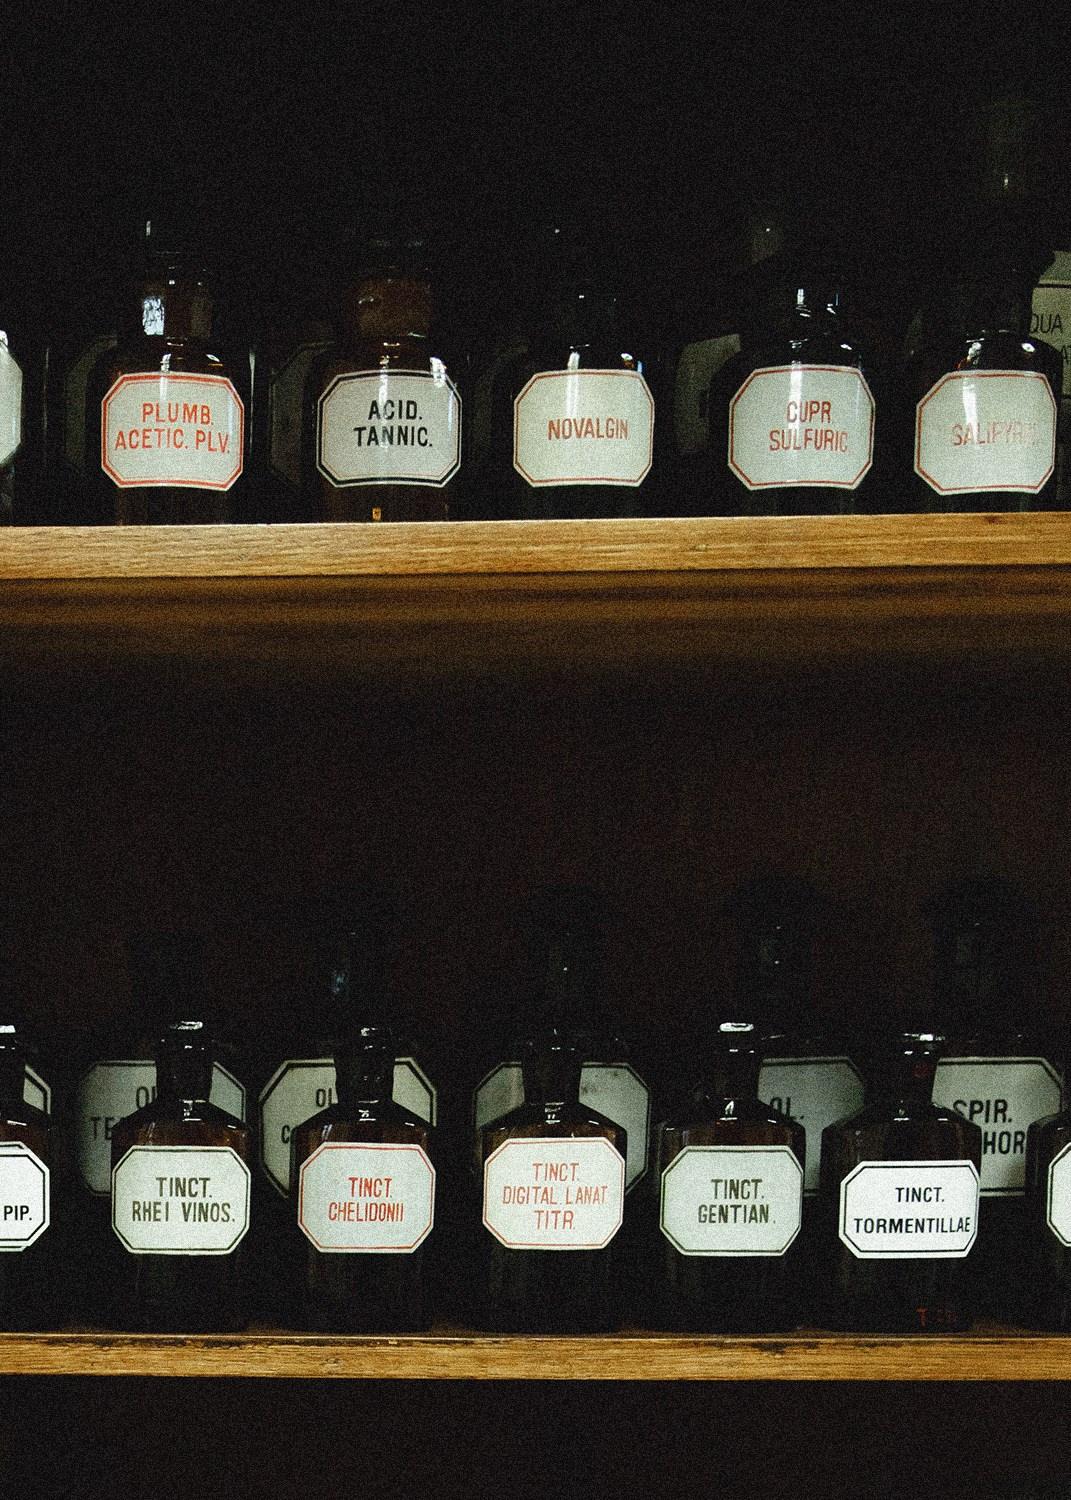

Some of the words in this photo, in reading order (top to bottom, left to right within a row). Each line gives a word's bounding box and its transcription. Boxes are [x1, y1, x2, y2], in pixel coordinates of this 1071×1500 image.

[142, 402, 215, 426] PLUMB.
[367, 399, 423, 420] ACID.
[786, 400, 832, 423] CUPR
[353, 425, 433, 447] TANNIC.
[548, 416, 629, 440] NOVALGIN
[114, 428, 189, 451] ACETIC.
[195, 429, 230, 454] PLV.
[769, 428, 849, 453] SULFURIC
[952, 1098, 1013, 1124] SPIR.
[532, 1162, 581, 1182] TINCT.
[156, 1176, 213, 1199] TINCT.
[348, 1177, 393, 1199] TINCT.
[711, 1178, 765, 1200] TINCT.
[895, 1186, 946, 1203] TINCT.
[3, 1205, 33, 1221] PIP.
[131, 1201, 169, 1222] RHEI
[181, 1202, 235, 1223] VINOS.
[328, 1202, 404, 1222] CHELIDONII
[697, 1204, 777, 1224] GENTIAN.
[853, 1217, 971, 1234] TORMENTILLAE
